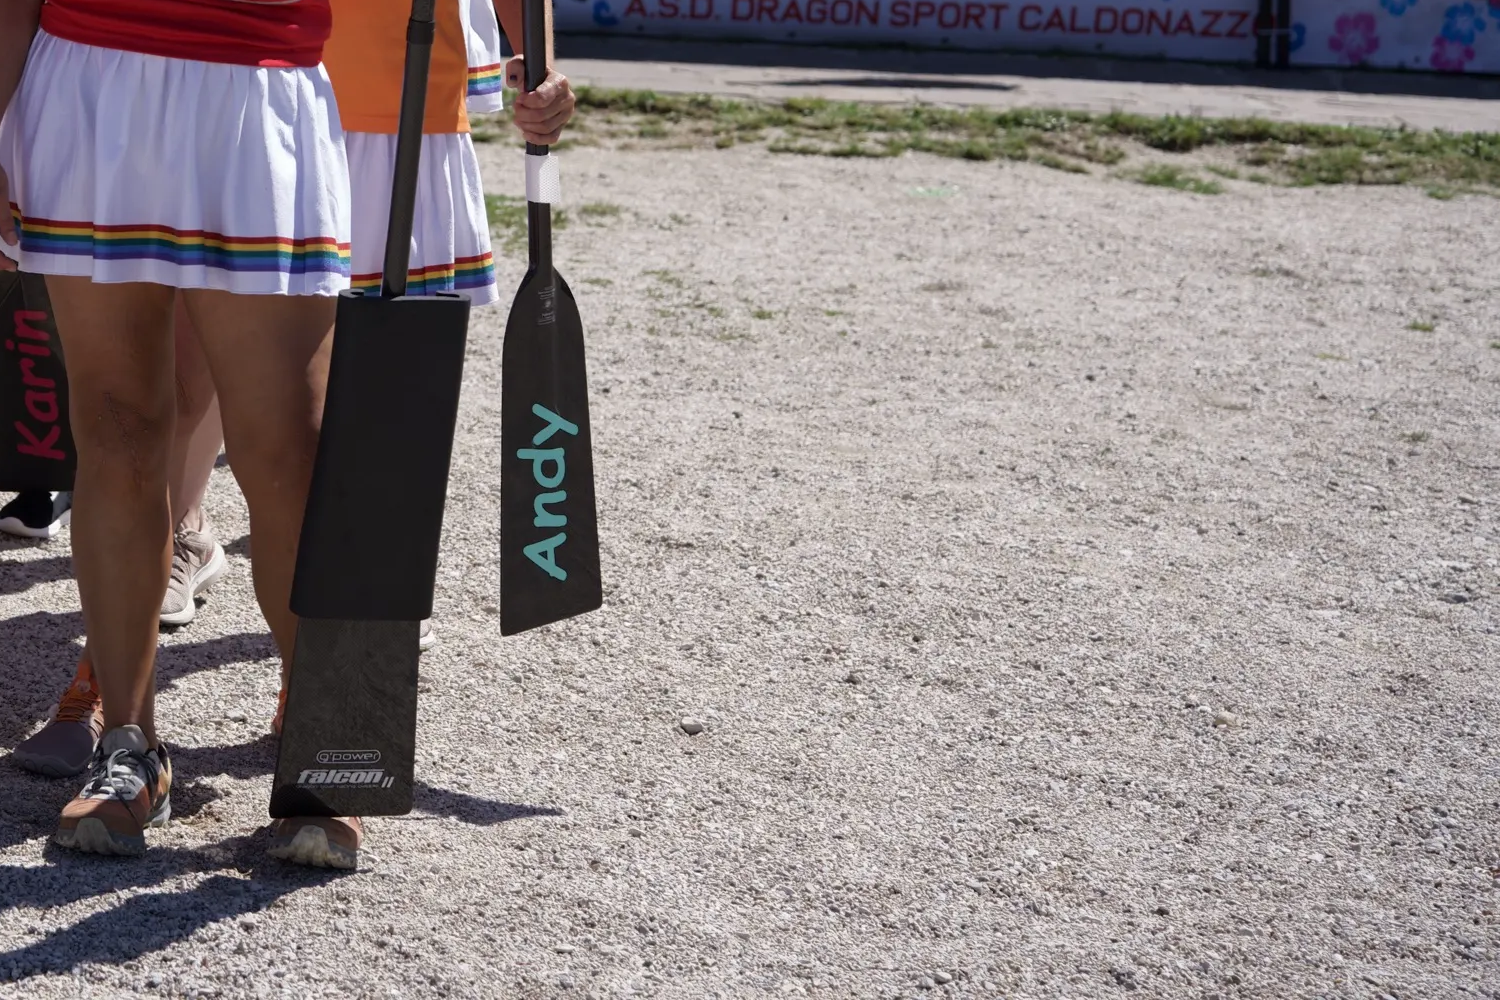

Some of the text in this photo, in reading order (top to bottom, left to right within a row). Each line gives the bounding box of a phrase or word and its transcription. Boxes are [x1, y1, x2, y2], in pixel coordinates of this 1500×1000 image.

[888, 0, 1009, 32] SPORT
[5, 309, 67, 462] Karin
[516, 402, 579, 582] Andy
[296, 768, 385, 785] falcon
